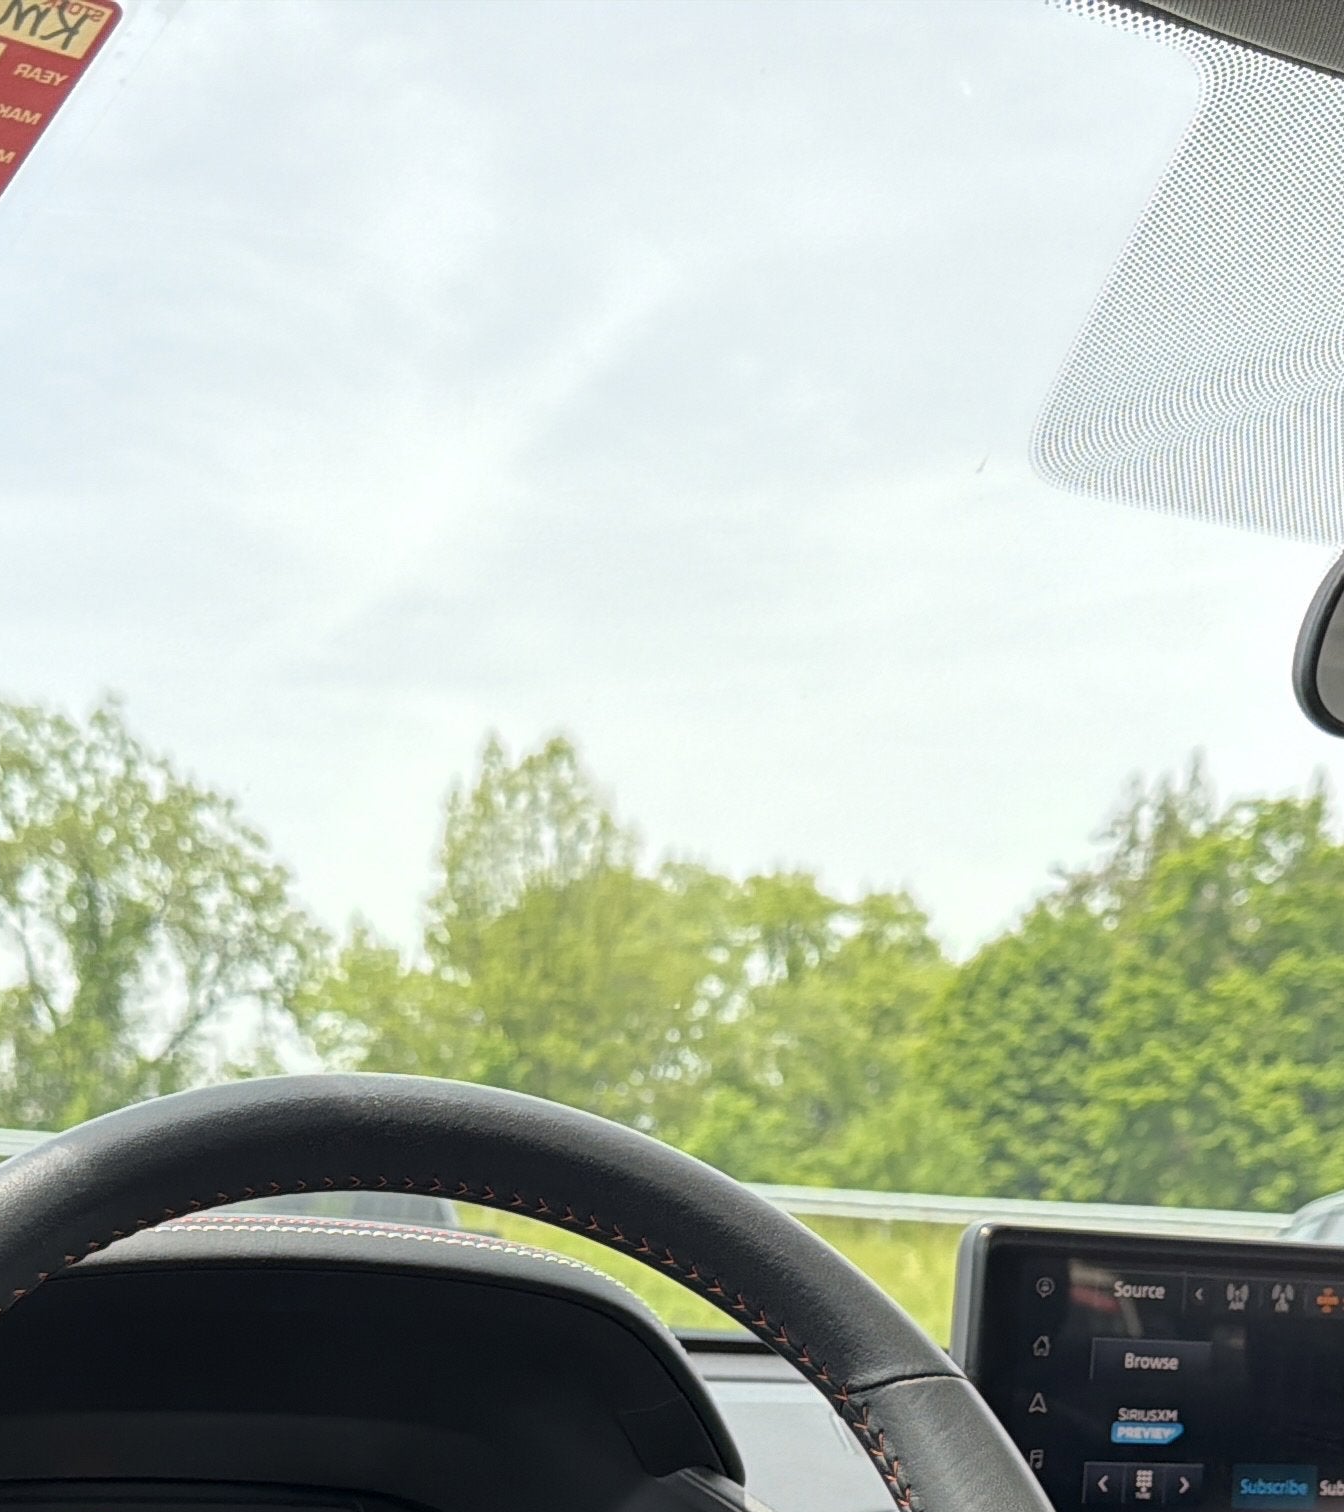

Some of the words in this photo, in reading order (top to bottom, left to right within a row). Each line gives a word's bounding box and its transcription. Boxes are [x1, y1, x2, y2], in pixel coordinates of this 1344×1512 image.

[1113, 1281, 1166, 1299] Source
[1124, 1353, 1179, 1370] Browse
[1240, 1478, 1309, 1495] Subscribe
